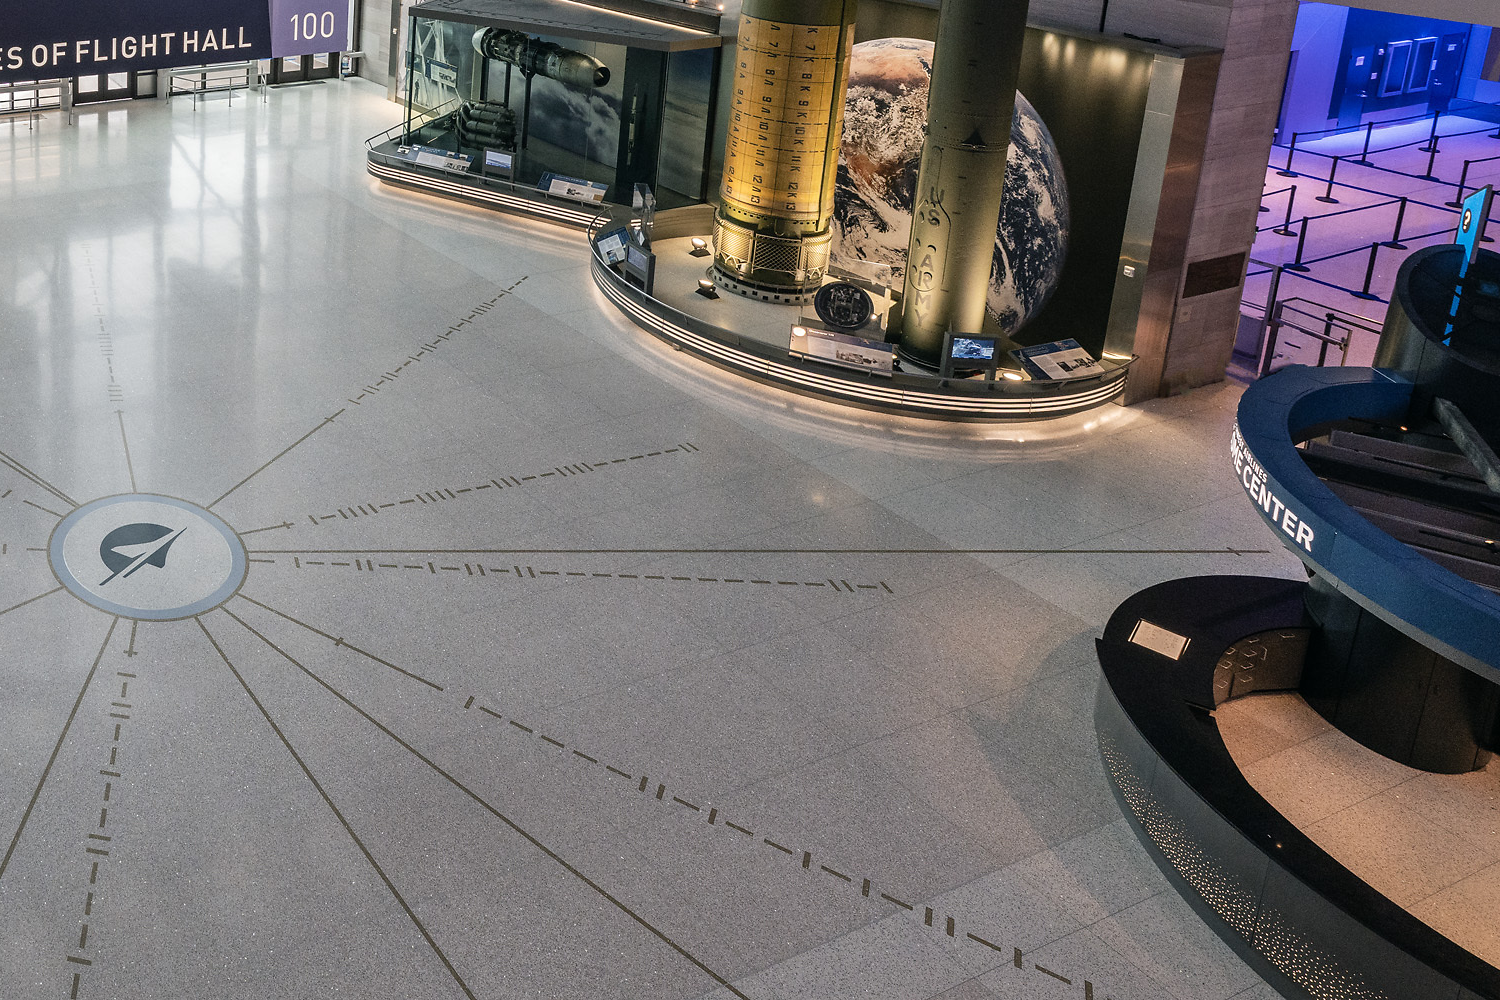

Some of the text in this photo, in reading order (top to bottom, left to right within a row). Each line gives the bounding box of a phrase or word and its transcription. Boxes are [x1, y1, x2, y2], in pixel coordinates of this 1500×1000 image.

[290, 11, 335, 40] 100
[31, 42, 68, 66] OF
[75, 32, 176, 63] FLIGHT
[182, 26, 252, 53] HALL
[914, 254, 934, 327] ARMY
[1242, 448, 1268, 483] AIRLINES
[1243, 465, 1314, 552] CENTER
